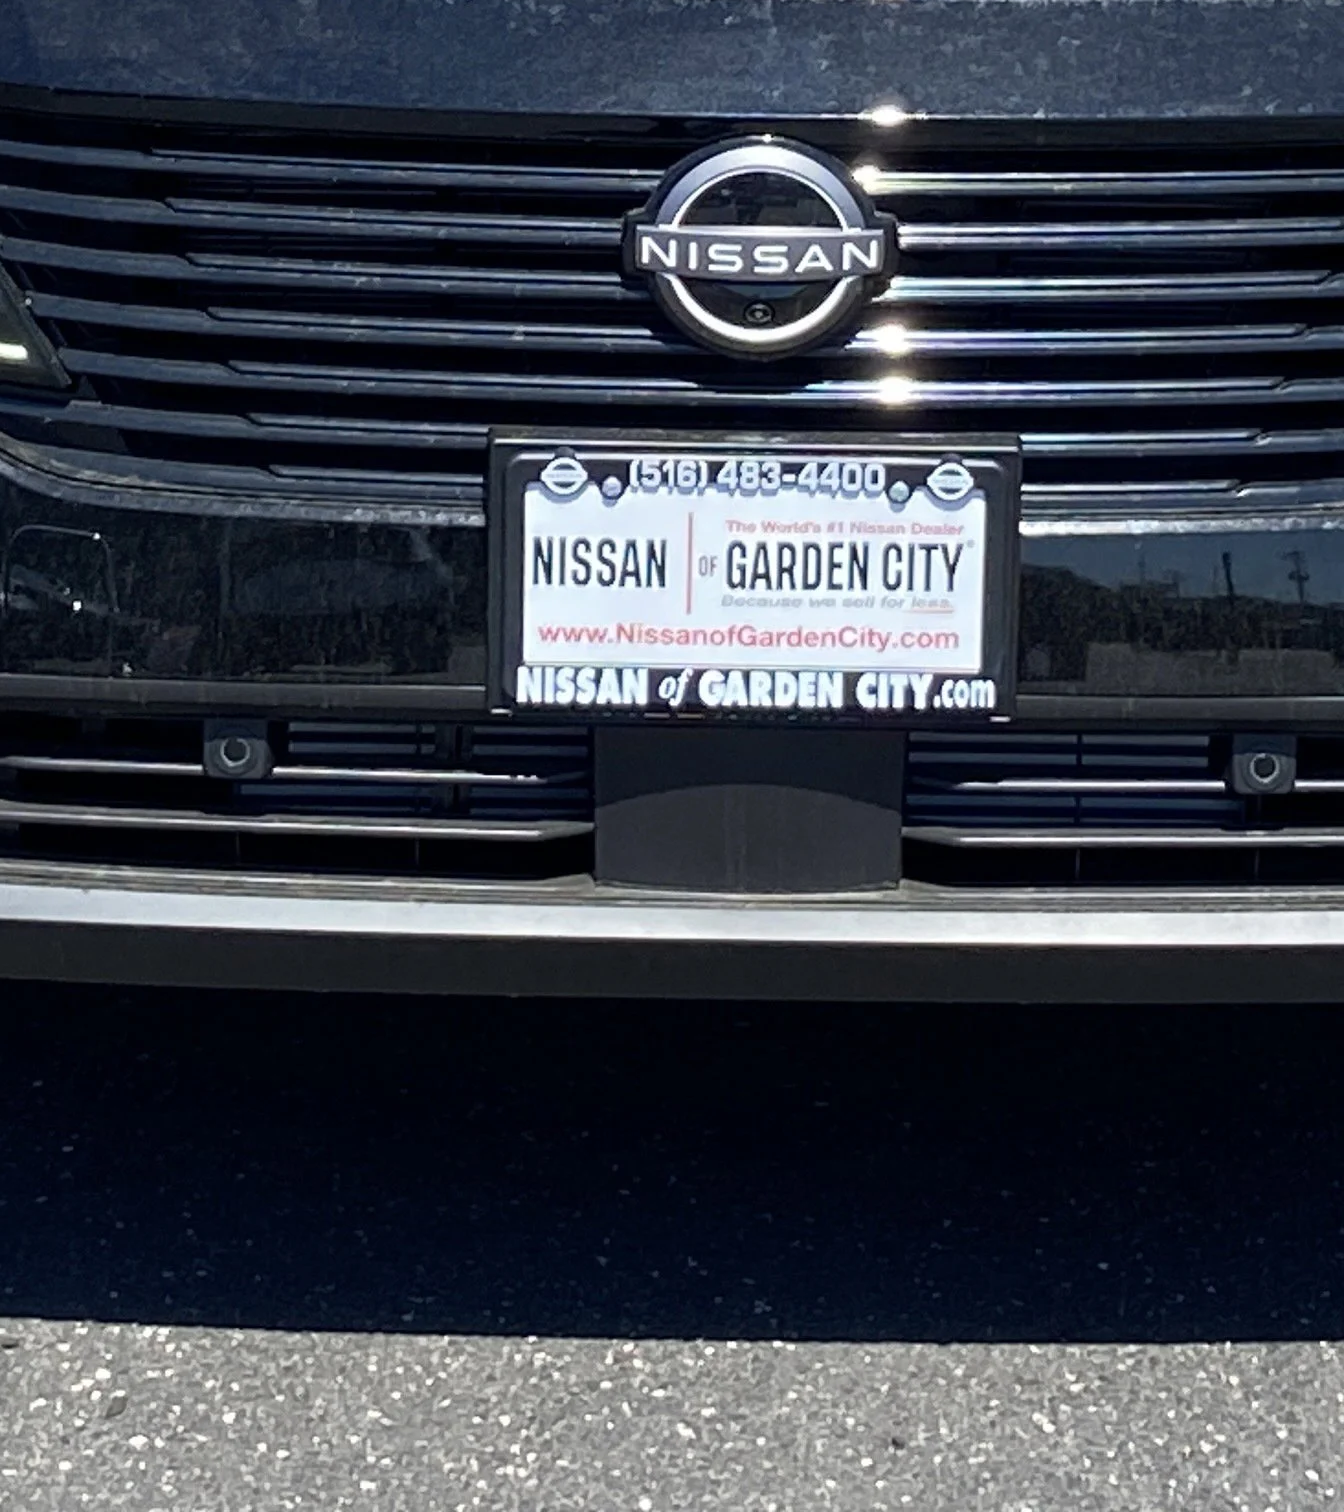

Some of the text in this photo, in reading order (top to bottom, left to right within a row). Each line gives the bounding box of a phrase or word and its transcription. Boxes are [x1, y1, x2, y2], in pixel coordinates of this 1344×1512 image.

[640, 235, 879, 274] NISSAN
[629, 459, 886, 492] (516) 483-4400
[724, 519, 965, 536] The World's #1 Nissan Dealer
[532, 535, 964, 592] NISSAN OF GARDEN CITY
[808, 597, 836, 608] we
[880, 595, 906, 609] for
[538, 622, 960, 653] www.NissanofGardenCity.com
[516, 664, 996, 710] NISSAN of GARDEN CITY.com
